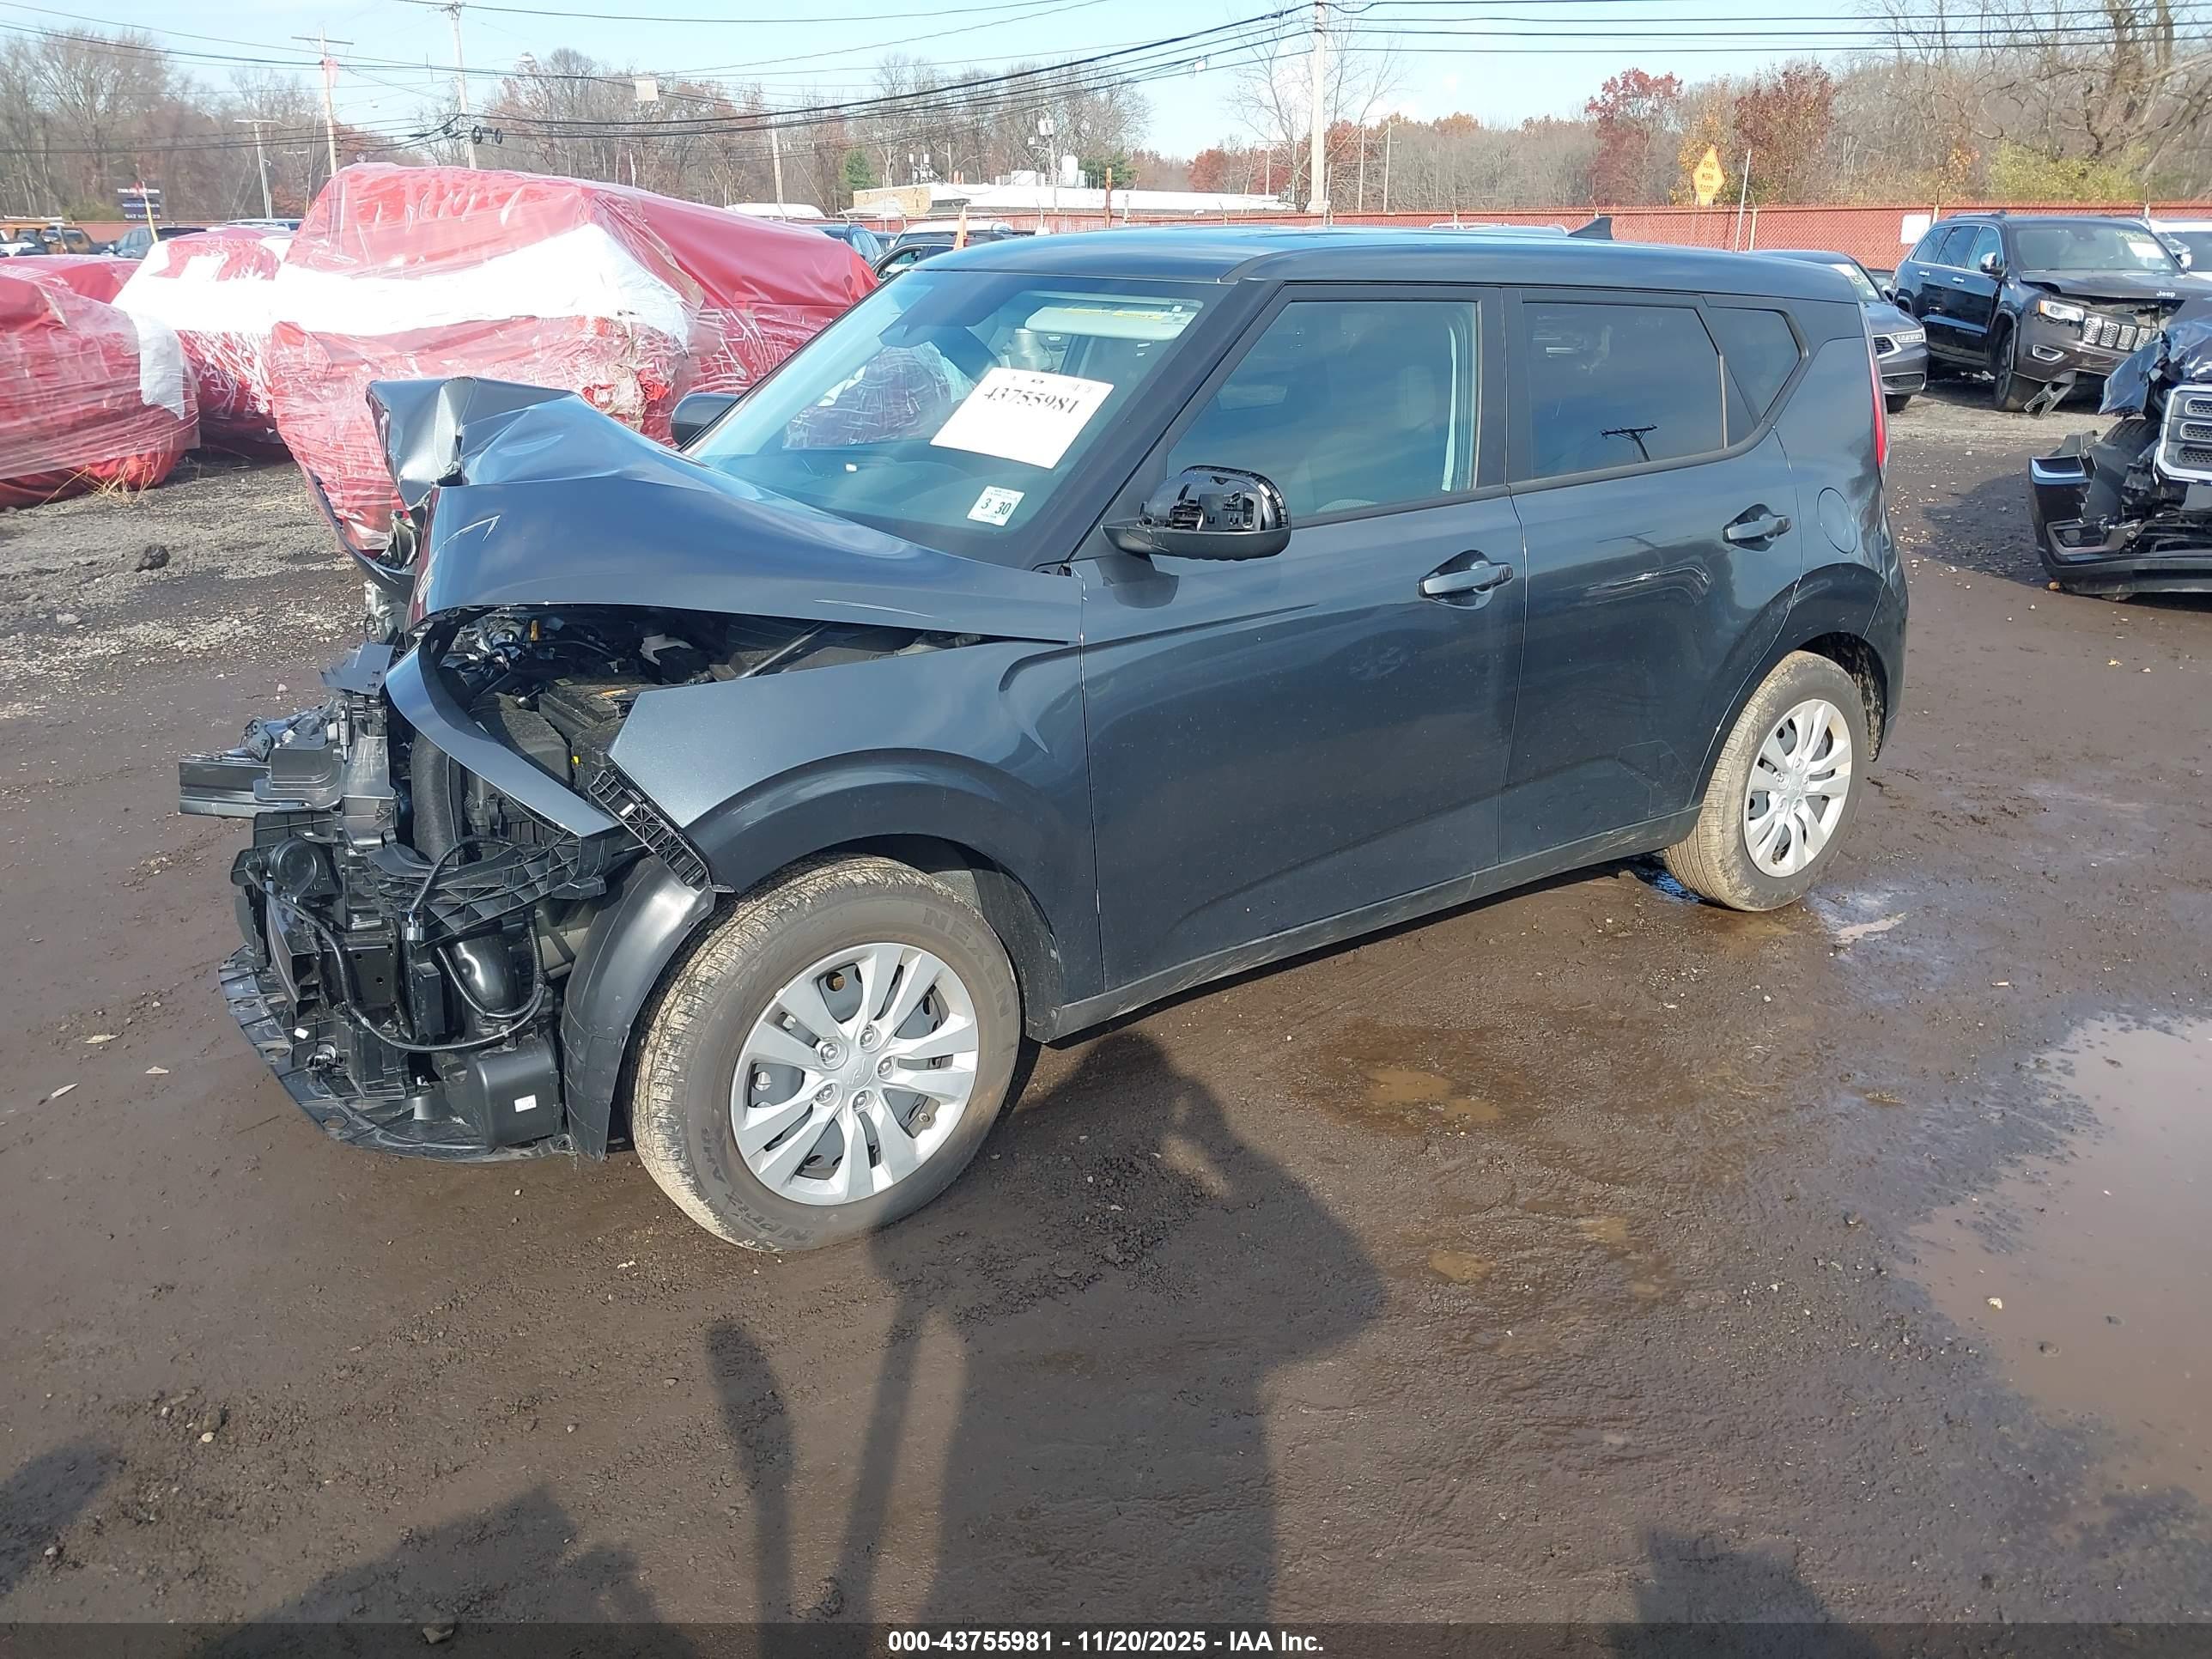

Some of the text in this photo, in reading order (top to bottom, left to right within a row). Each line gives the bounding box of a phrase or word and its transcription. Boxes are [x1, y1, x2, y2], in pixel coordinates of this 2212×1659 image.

[984, 386, 1079, 414] 43755981
[981, 497, 1012, 515] 3 30
[921, 907, 1012, 1018] NEXEN
